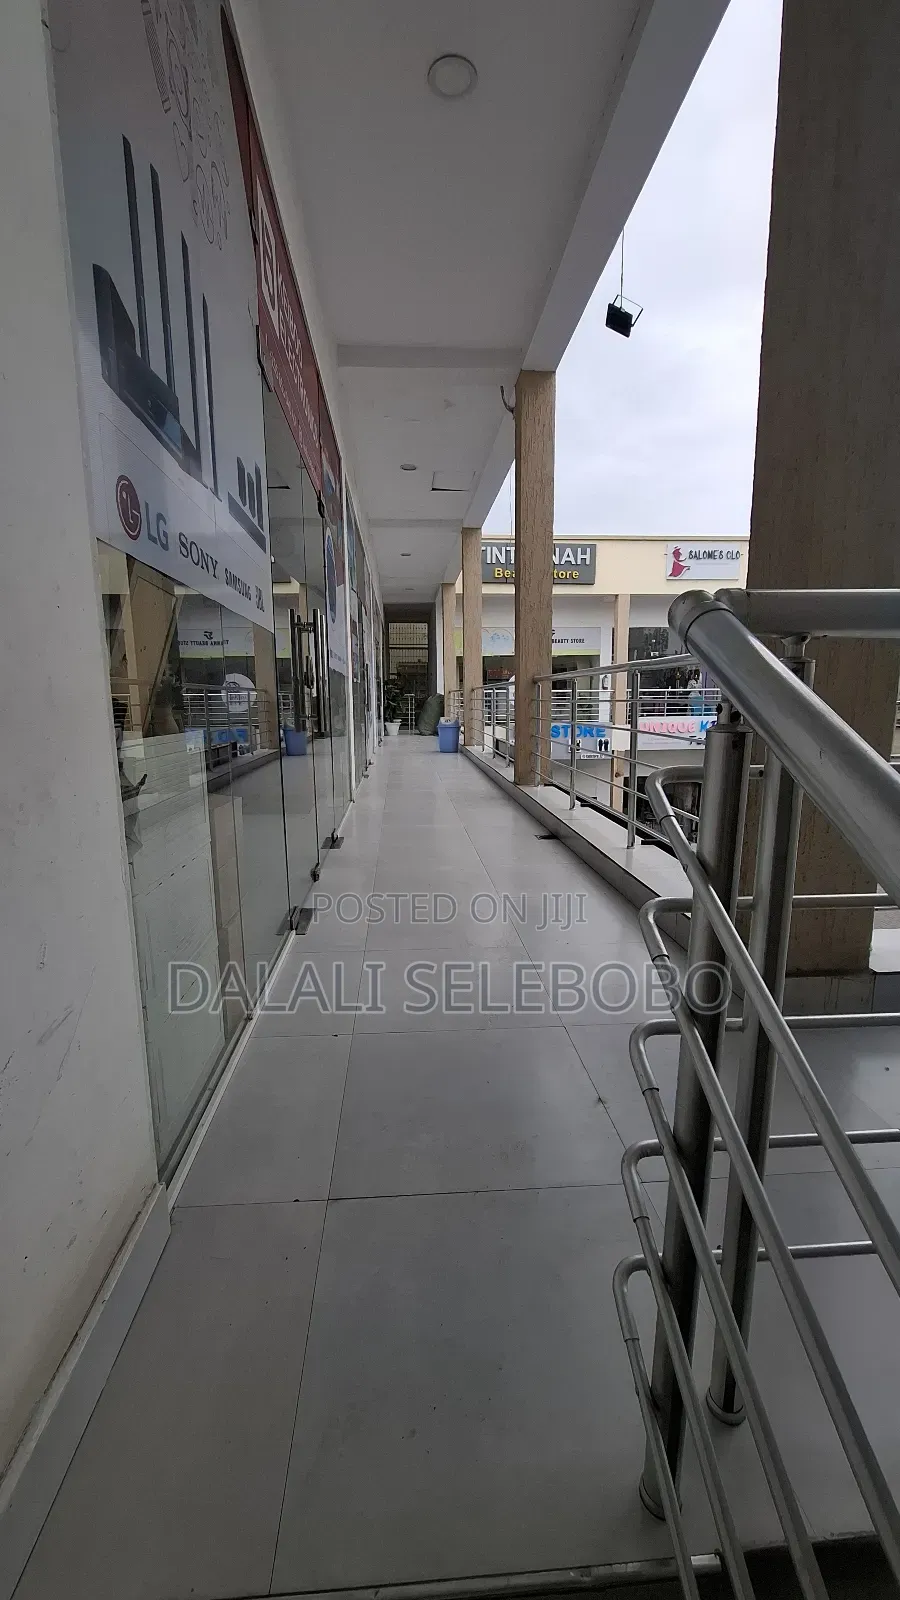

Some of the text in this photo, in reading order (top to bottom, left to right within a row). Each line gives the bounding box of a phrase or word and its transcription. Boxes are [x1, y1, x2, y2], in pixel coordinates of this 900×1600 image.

[144, 500, 170, 552] LG
[178, 531, 219, 580] SONY
[224, 567, 252, 601] SAMSUNG
[550, 725, 606, 738] STORE
[639, 720, 695, 734] UNIQUE
